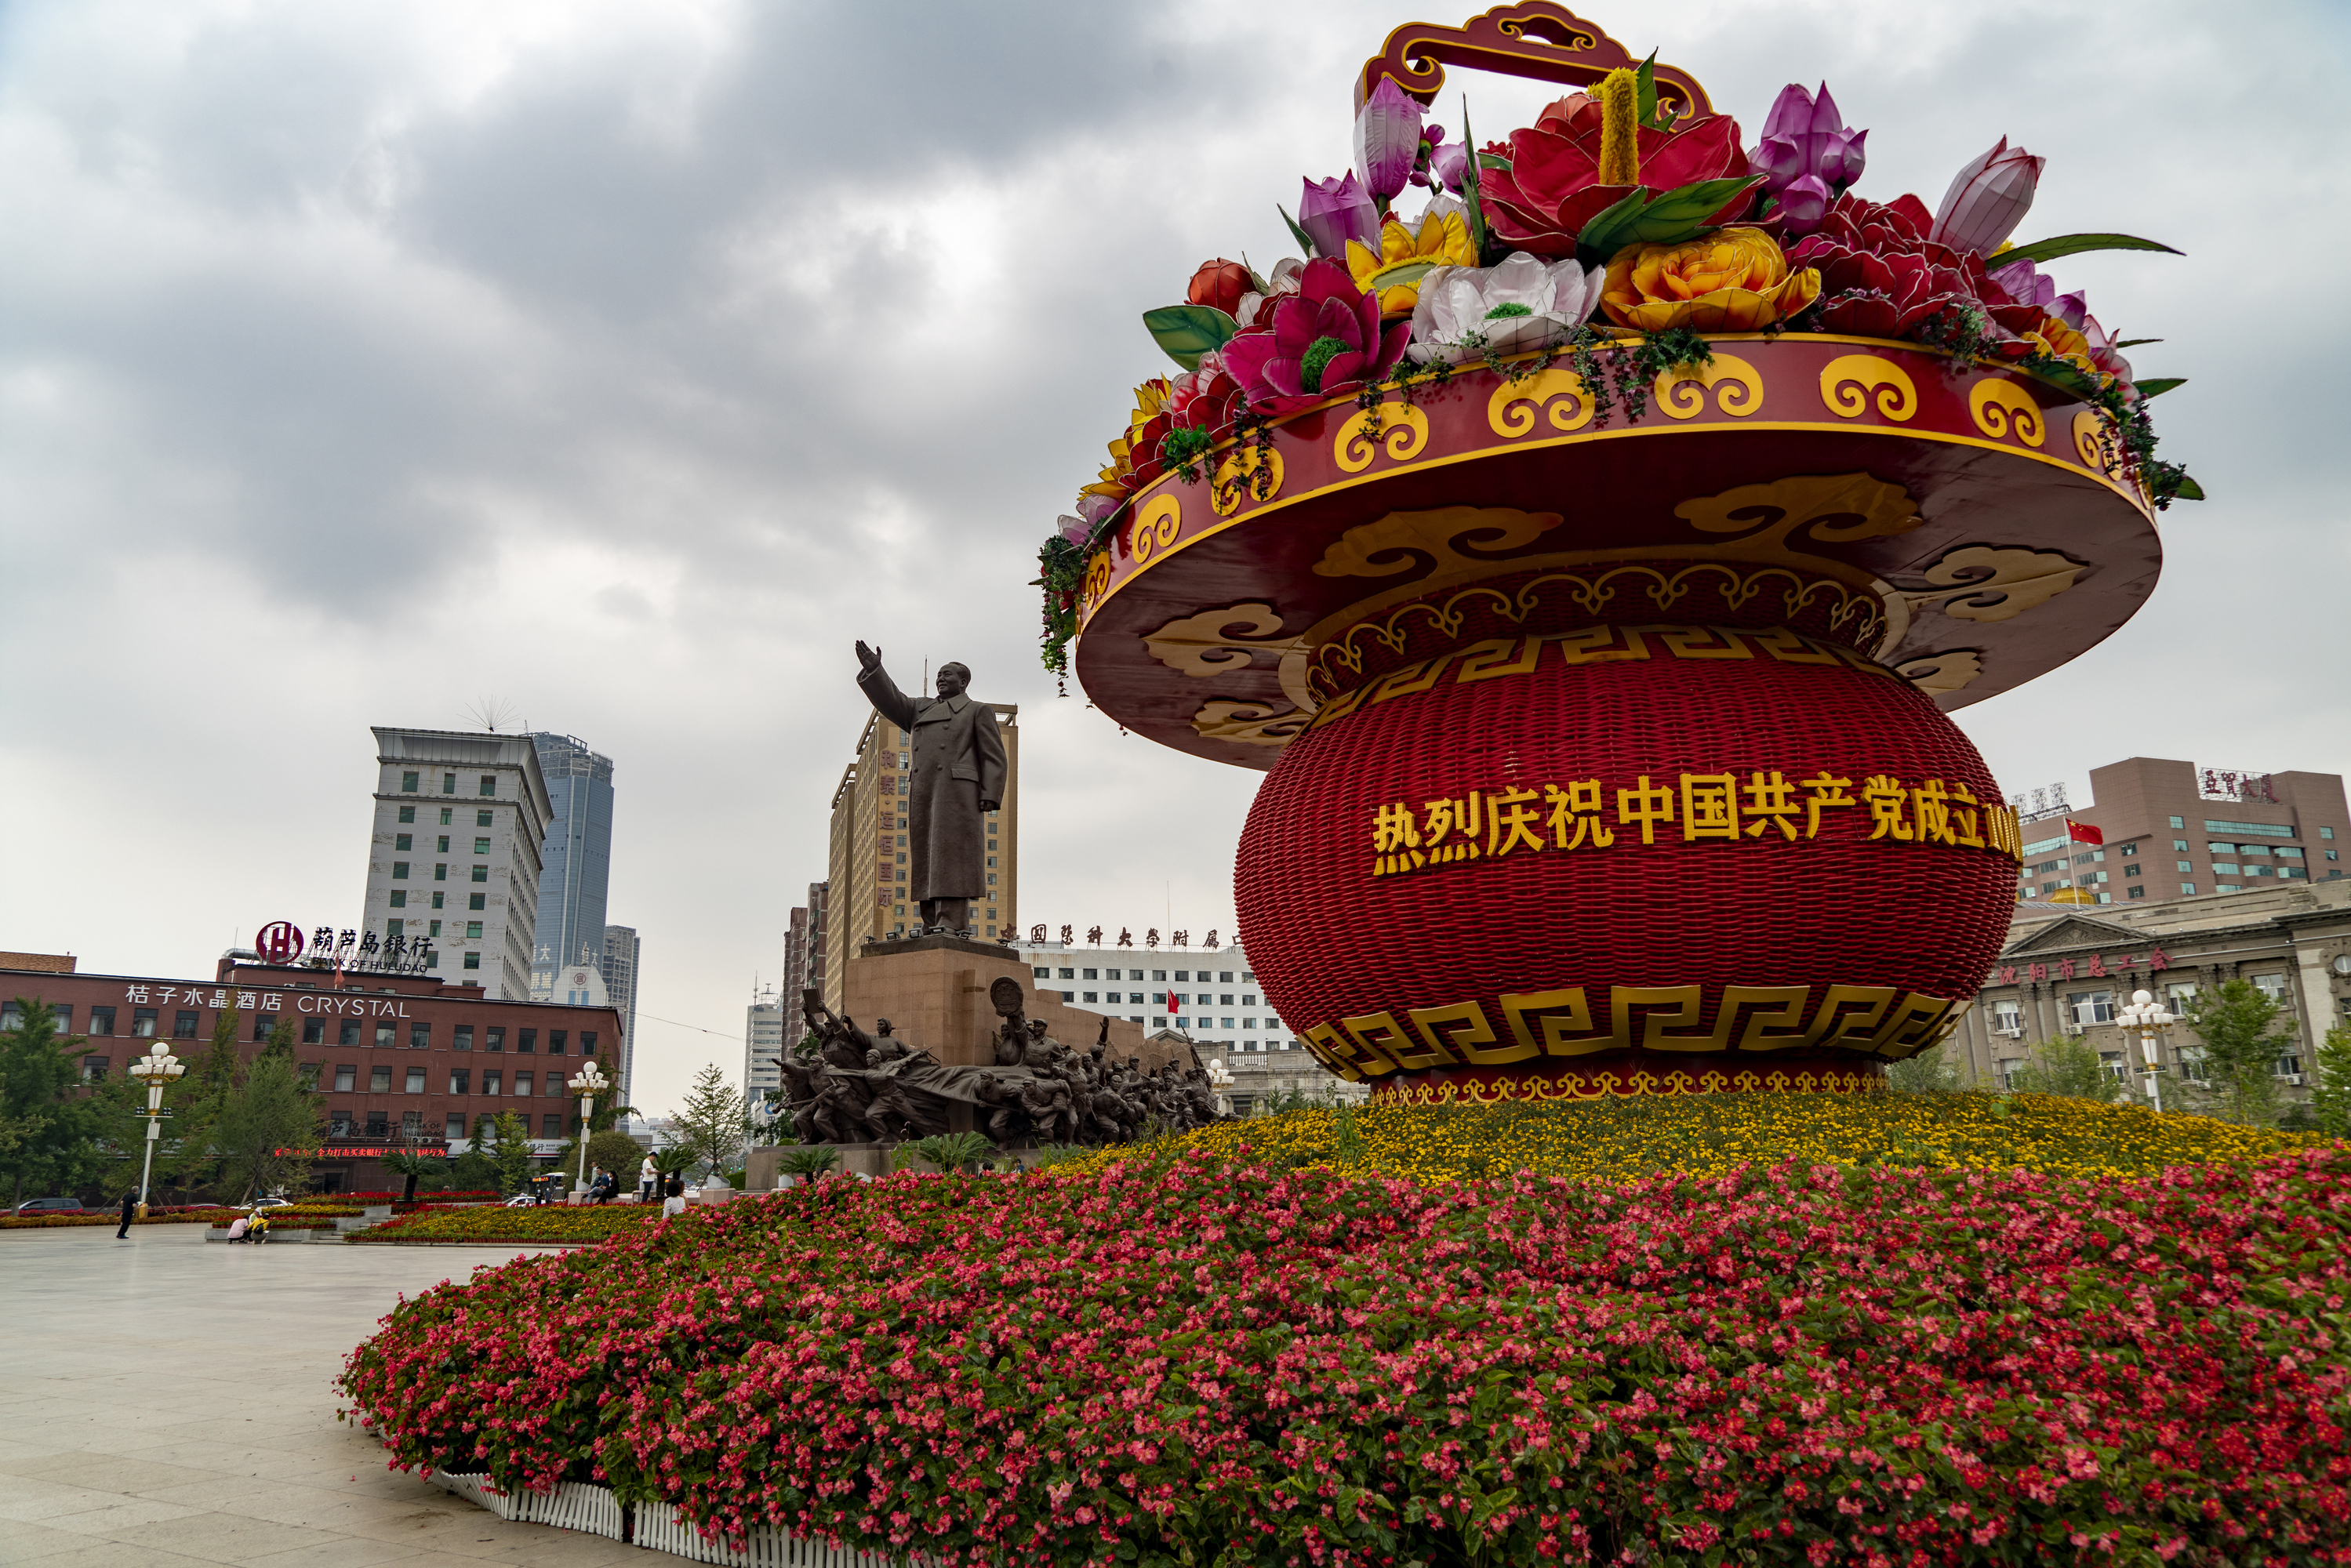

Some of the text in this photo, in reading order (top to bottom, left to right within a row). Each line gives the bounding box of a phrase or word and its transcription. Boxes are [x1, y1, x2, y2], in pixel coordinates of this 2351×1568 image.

[1372, 771, 2023, 876] 热烈庆祝中国共产党成立100
[314, 927, 434, 959] 葫芦岛银行
[312, 957, 428, 973] BANK OF HULUDAO
[1998, 946, 2175, 985] 沈阳市总工会
[125, 984, 411, 1018] 桔子水晶酒店 CRYSTAL
[523, 1142, 544, 1152] 银行
